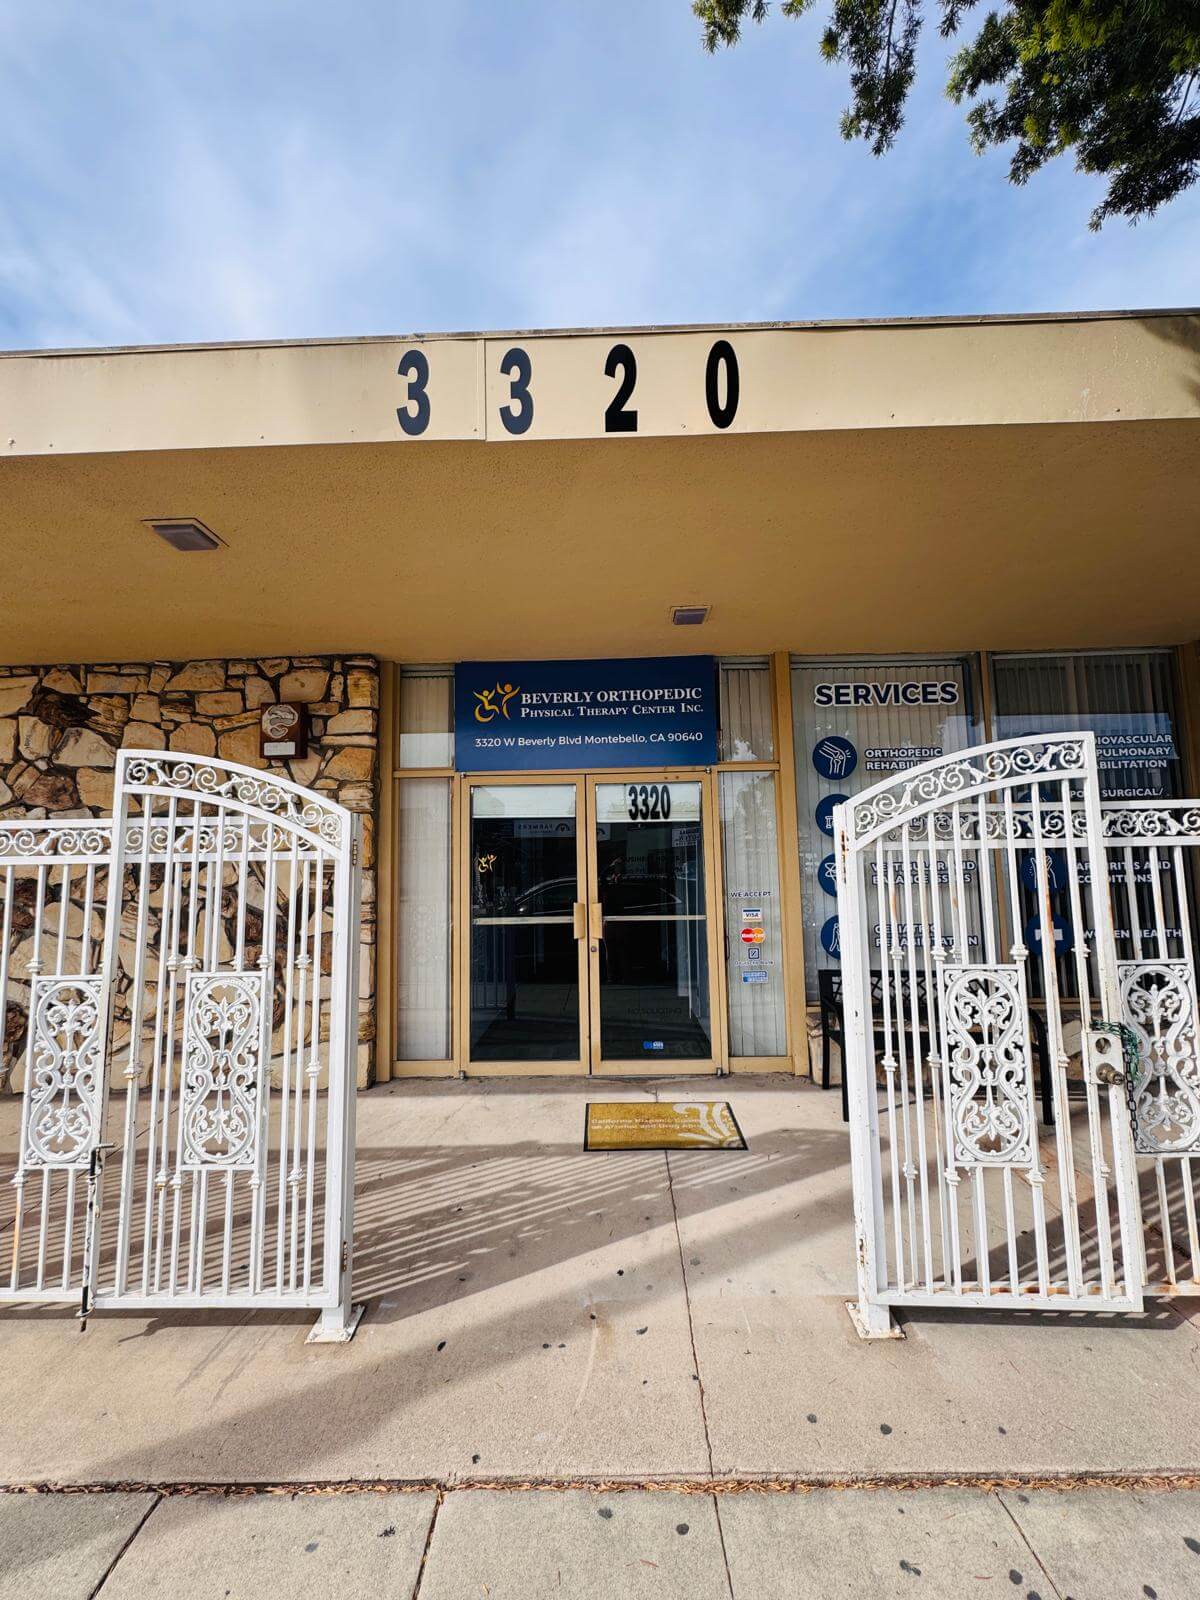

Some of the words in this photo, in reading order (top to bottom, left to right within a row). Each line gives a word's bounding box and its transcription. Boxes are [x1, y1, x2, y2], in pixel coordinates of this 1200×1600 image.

[520, 690, 594, 705] BEVERLY
[596, 687, 702, 702] ORTHOPEDIC
[814, 681, 960, 707] SERVICES
[520, 706, 574, 718] PHYSICAL
[577, 705, 629, 717] THERAPY
[632, 703, 675, 715] CENTER
[474, 737, 501, 747] 3320
[503, 737, 517, 747] W
[518, 735, 556, 749] Beverly
[558, 734, 582, 745] Blvd
[584, 733, 648, 745] Montebello,
[649, 733, 666, 742] CA
[667, 732, 703, 742] 90640
[1094, 734, 1173, 745] IOVASCULAR
[865, 748, 943, 758] ORTHOPEDIC
[1096, 746, 1171, 757] PULMONARY
[1097, 760, 1167, 769] BILITATION
[1102, 788, 1163, 797] SURGICAL/
[628, 784, 671, 821] 3320
[1143, 861, 1171, 870] AD
